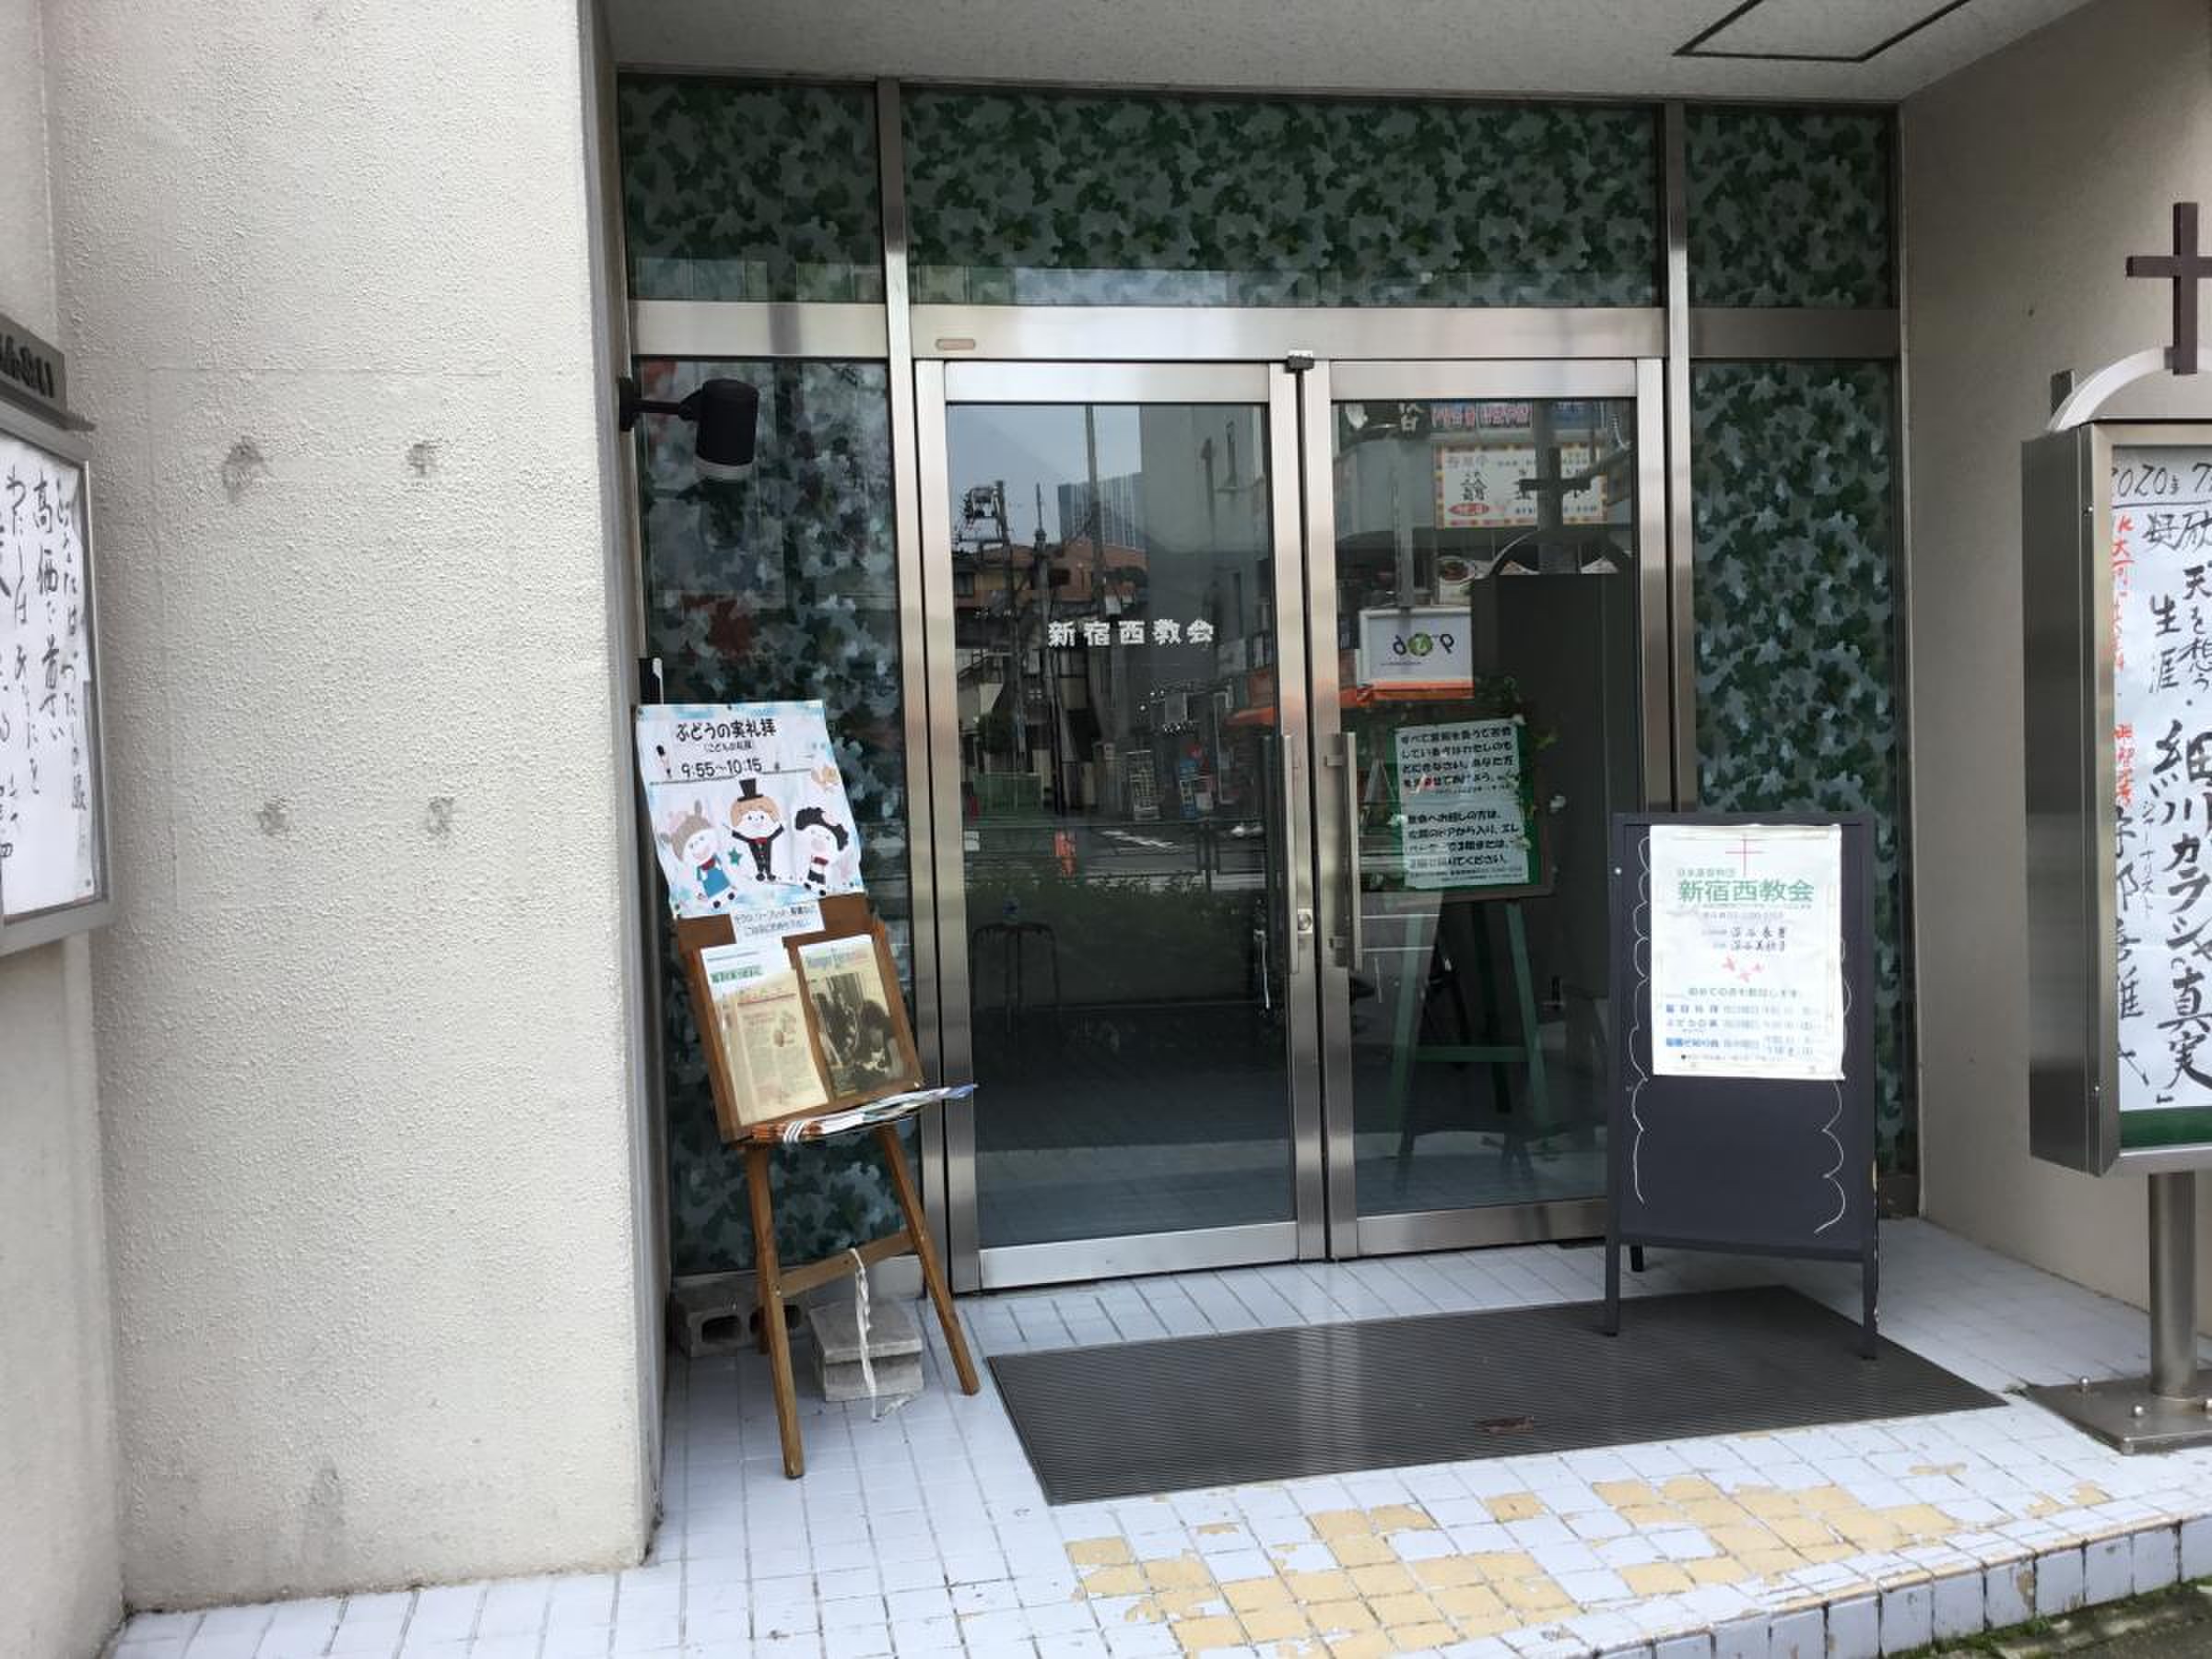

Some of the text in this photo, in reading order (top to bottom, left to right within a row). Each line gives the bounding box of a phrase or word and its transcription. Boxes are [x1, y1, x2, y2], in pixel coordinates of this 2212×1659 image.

[1047, 618, 1215, 647] 新宿西教会
[676, 718, 777, 742] ぶどうの実礼拝
[1678, 878, 1815, 902] 新宿西教会
